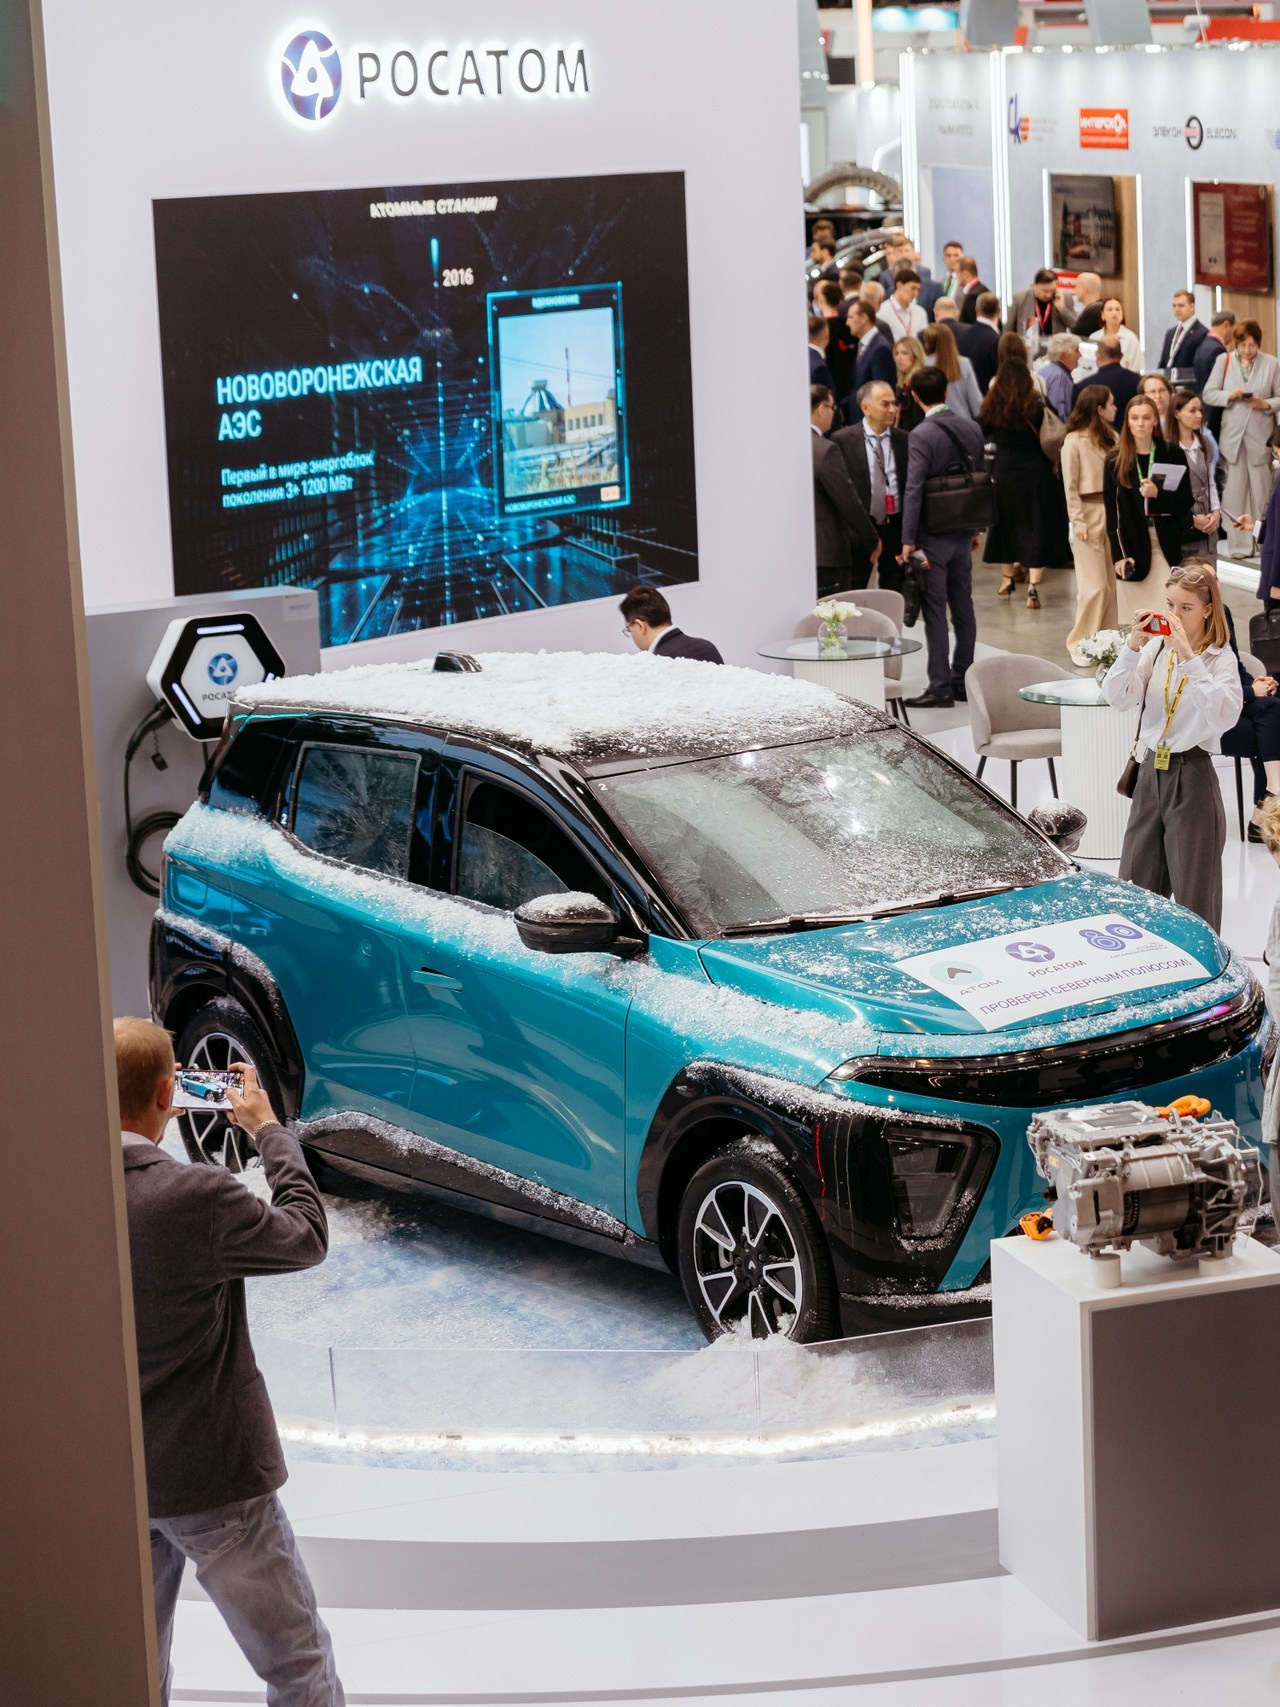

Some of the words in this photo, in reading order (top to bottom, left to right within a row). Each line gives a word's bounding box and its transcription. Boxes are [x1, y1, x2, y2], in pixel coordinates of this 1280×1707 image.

[357, 48, 589, 98] РОСАТОМ
[1206, 127, 1236, 139] ELECON
[370, 200, 436, 218] АТОМНЫЕ
[436, 196, 498, 214] СТАНЦИИ
[442, 267, 474, 287] 2016
[216, 356, 423, 404] НОВОВОРОНЕЖСКАЯ
[218, 409, 262, 441] АЭС
[221, 463, 268, 487] Первый
[269, 465, 278, 480] в
[278, 461, 309, 479] мире
[309, 450, 375, 474] энергоблок
[222, 486, 285, 508] поколения
[285, 481, 300, 499] 3+
[301, 476, 328, 496] 1200
[329, 473, 354, 492] МВт
[1028, 959, 1086, 977] РОСАТОМ
[959, 979, 1003, 996] АТОМ
[979, 989, 1051, 1015] ПРОВЕРЕН
[1050, 971, 1123, 996] СЕВЕРНЫМ
[1123, 957, 1192, 978] ПОЛЮСОМ!
